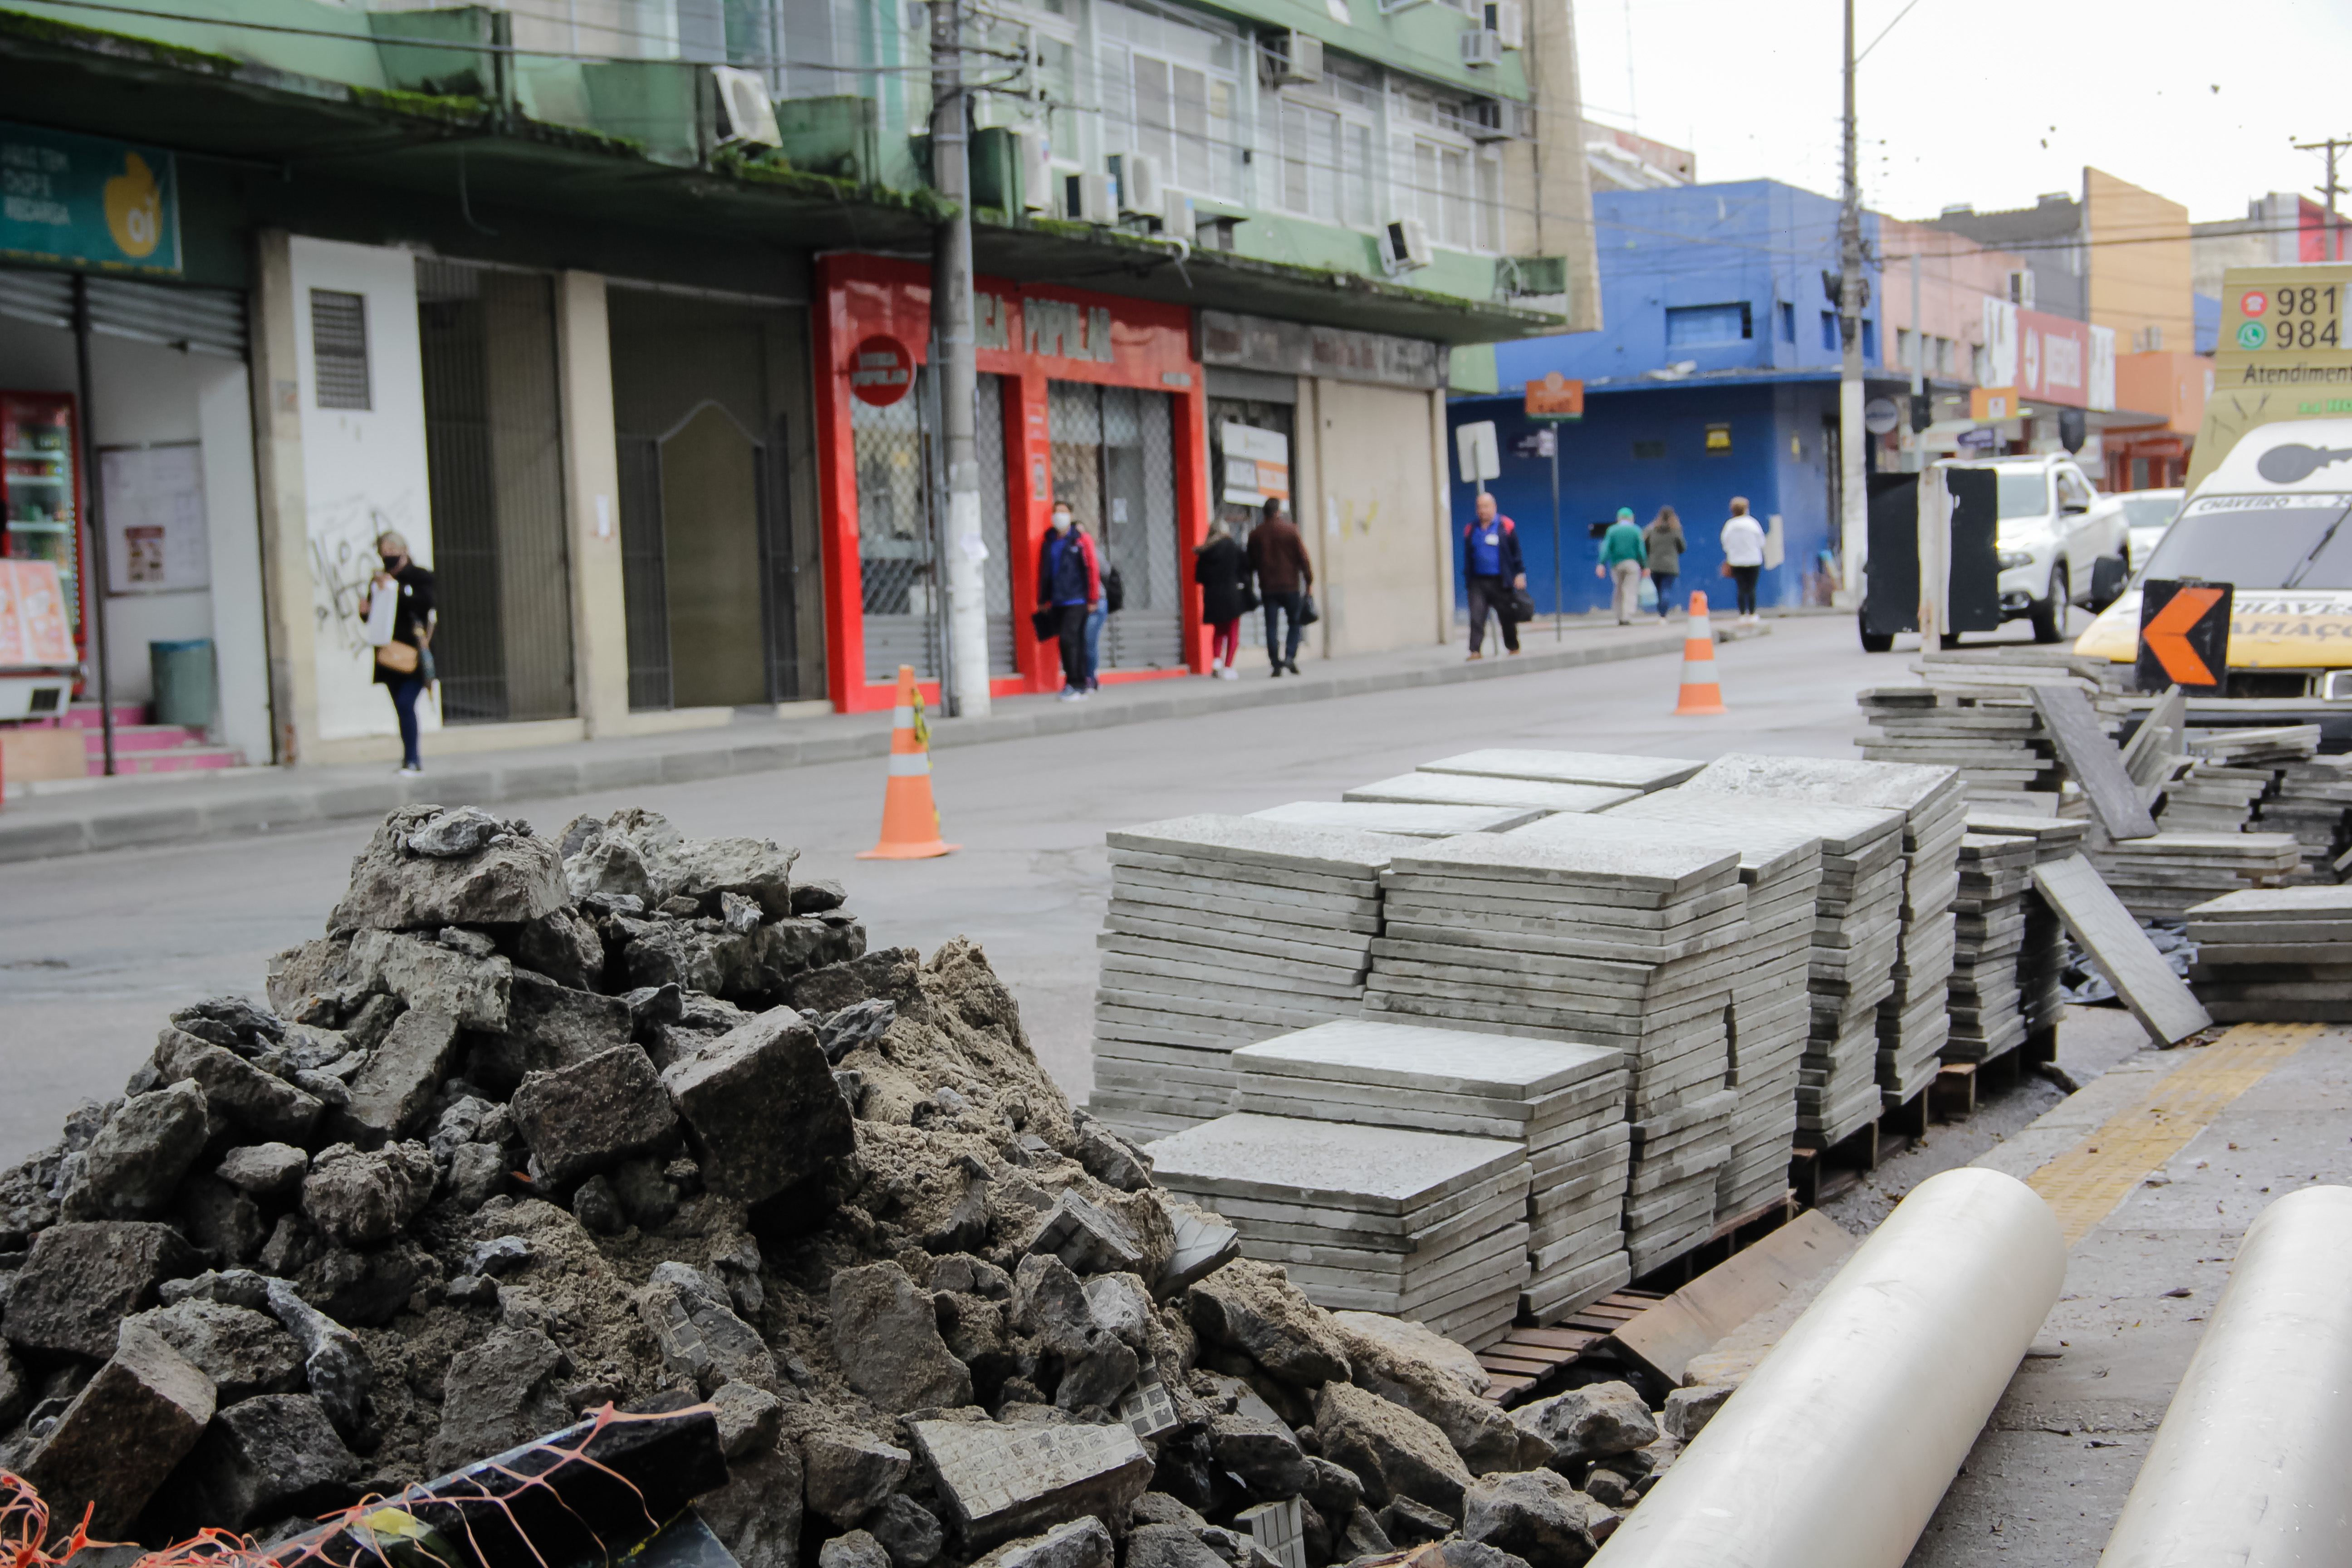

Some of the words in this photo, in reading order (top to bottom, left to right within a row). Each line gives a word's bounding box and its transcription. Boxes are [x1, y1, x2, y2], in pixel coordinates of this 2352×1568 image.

[2277, 285, 2336, 317] 981
[2276, 318, 2338, 349] 984
[2198, 496, 2290, 511] CHAVEIRO
[2233, 603, 2352, 614] HAVE
